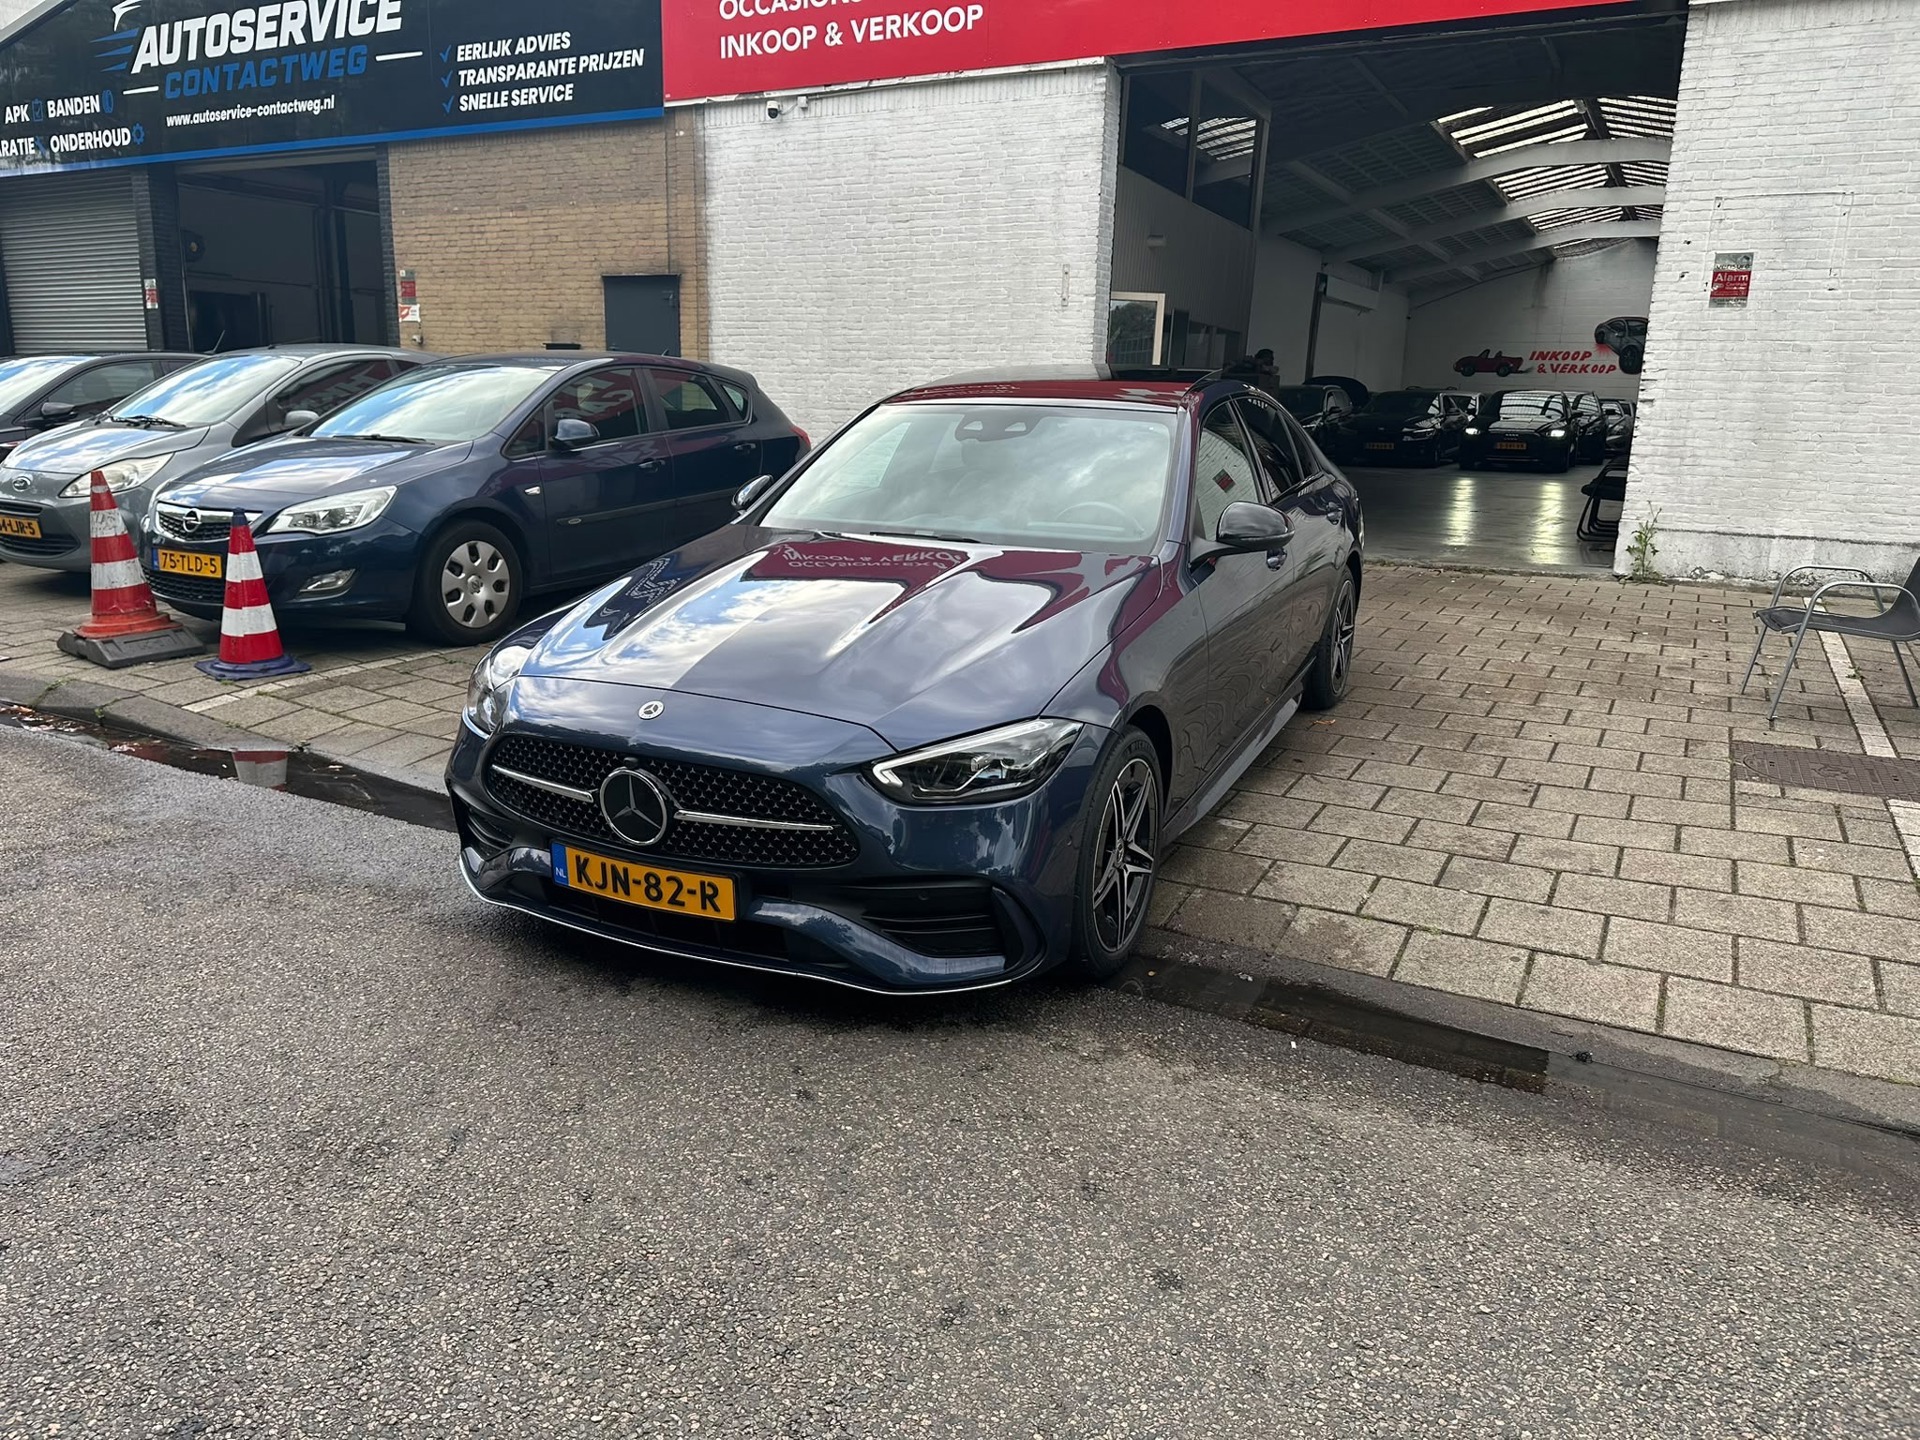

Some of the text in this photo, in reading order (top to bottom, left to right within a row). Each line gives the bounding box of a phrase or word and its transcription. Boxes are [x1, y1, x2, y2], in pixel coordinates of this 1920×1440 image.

[719, 0, 862, 20] OCCAS
[131, 0, 402, 74] AUTOSERVICE
[456, 31, 571, 62] EERLIJK ADVIES
[720, 4, 984, 59] INKOOP & VERKOOP
[165, 45, 368, 99] CONTACTWEG
[458, 48, 645, 87] TRANSPARANTE PRIJZEN
[5, 94, 100, 124] APK BANDEN
[166, 95, 335, 127] www.autoservice-contactweg.nl
[459, 83, 574, 112] SNELLE SERVICE
[0, 127, 131, 157] RATIE ONDERHOUD
[1714, 273, 1749, 282] Alarm
[1529, 350, 1592, 361] INKOOP
[1537, 363, 1617, 374] & VERKOOP
[162, 552, 217, 574] 75-TLD-5
[555, 867, 567, 879] NL
[575, 854, 721, 913] KJN-82-R
